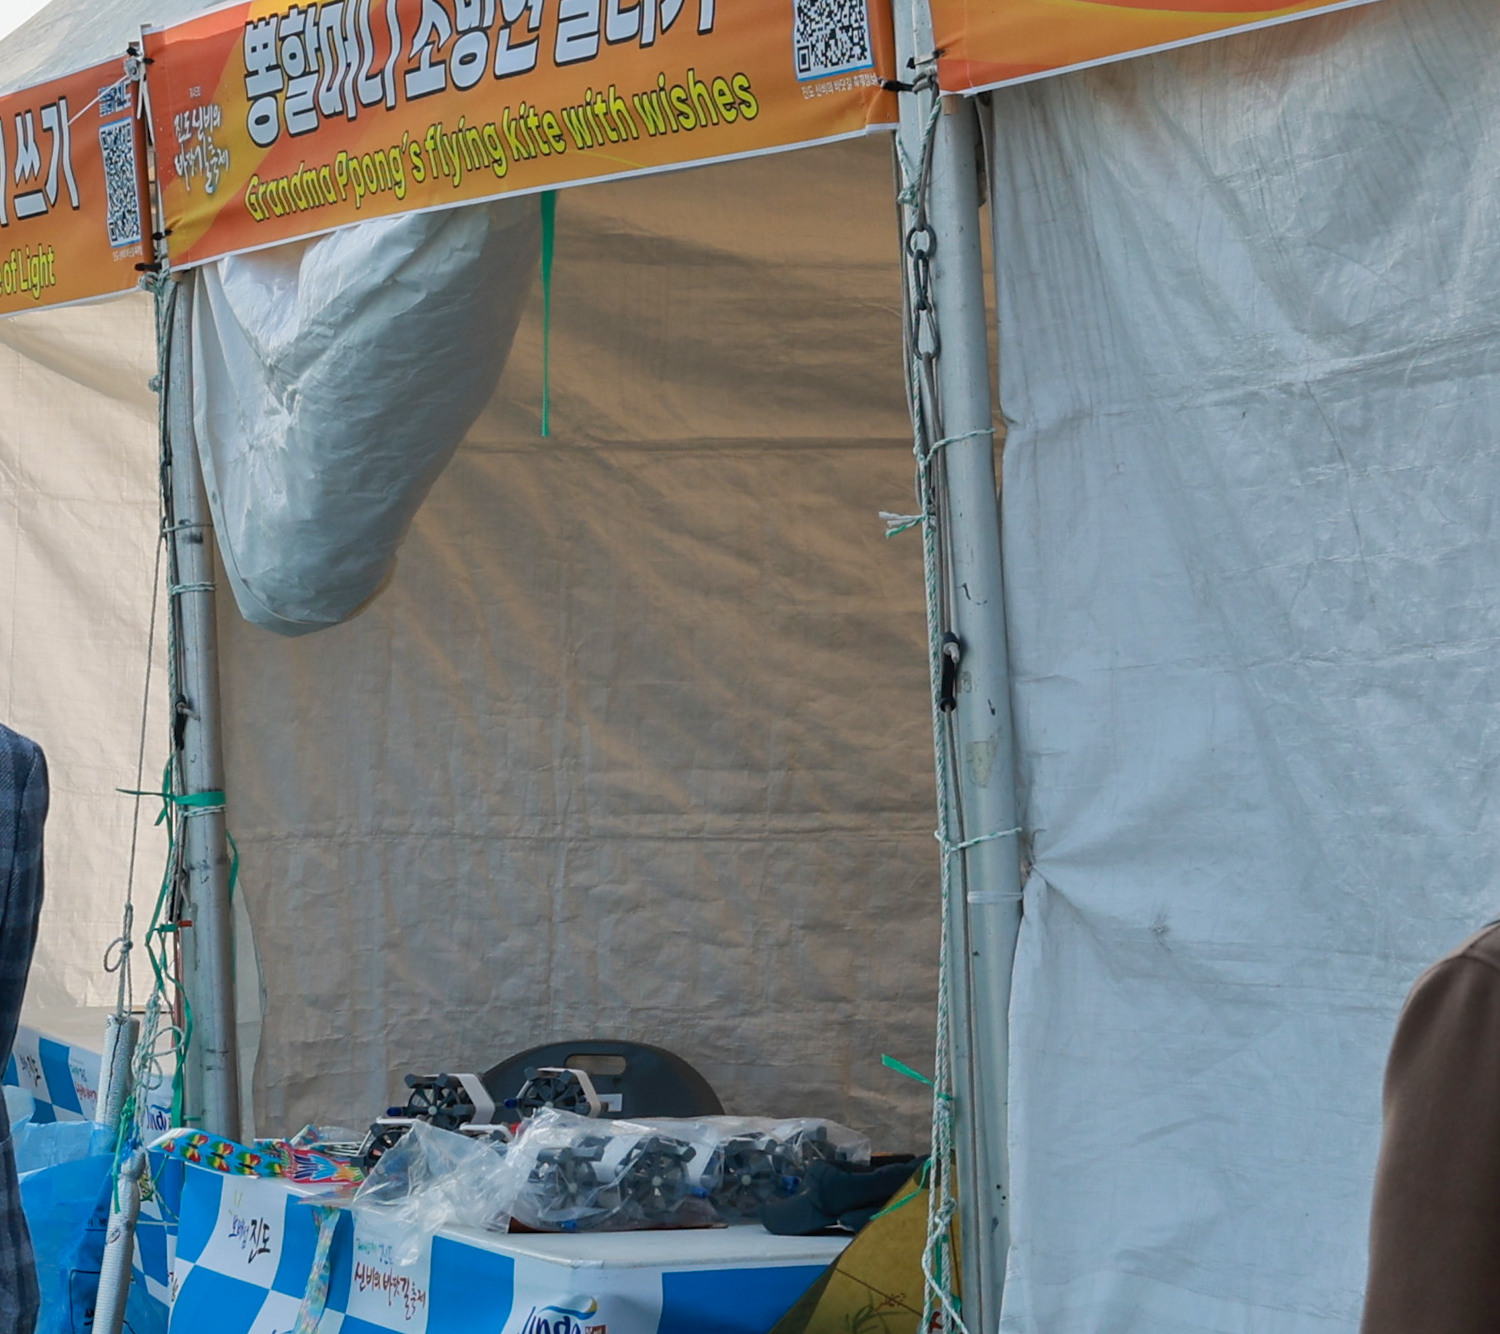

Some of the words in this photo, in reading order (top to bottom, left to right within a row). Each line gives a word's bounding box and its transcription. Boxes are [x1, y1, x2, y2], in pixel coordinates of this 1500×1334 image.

[13, 95, 80, 221] 쓰기
[245, 160, 337, 222] Grandma
[424, 116, 508, 188] flying
[502, 101, 567, 161] kite
[561, 84, 640, 150] with
[632, 67, 759, 137] wishes
[3, 248, 18, 295] of
[16, 243, 57, 300] Light
[248, 1217, 271, 1264] 진도
